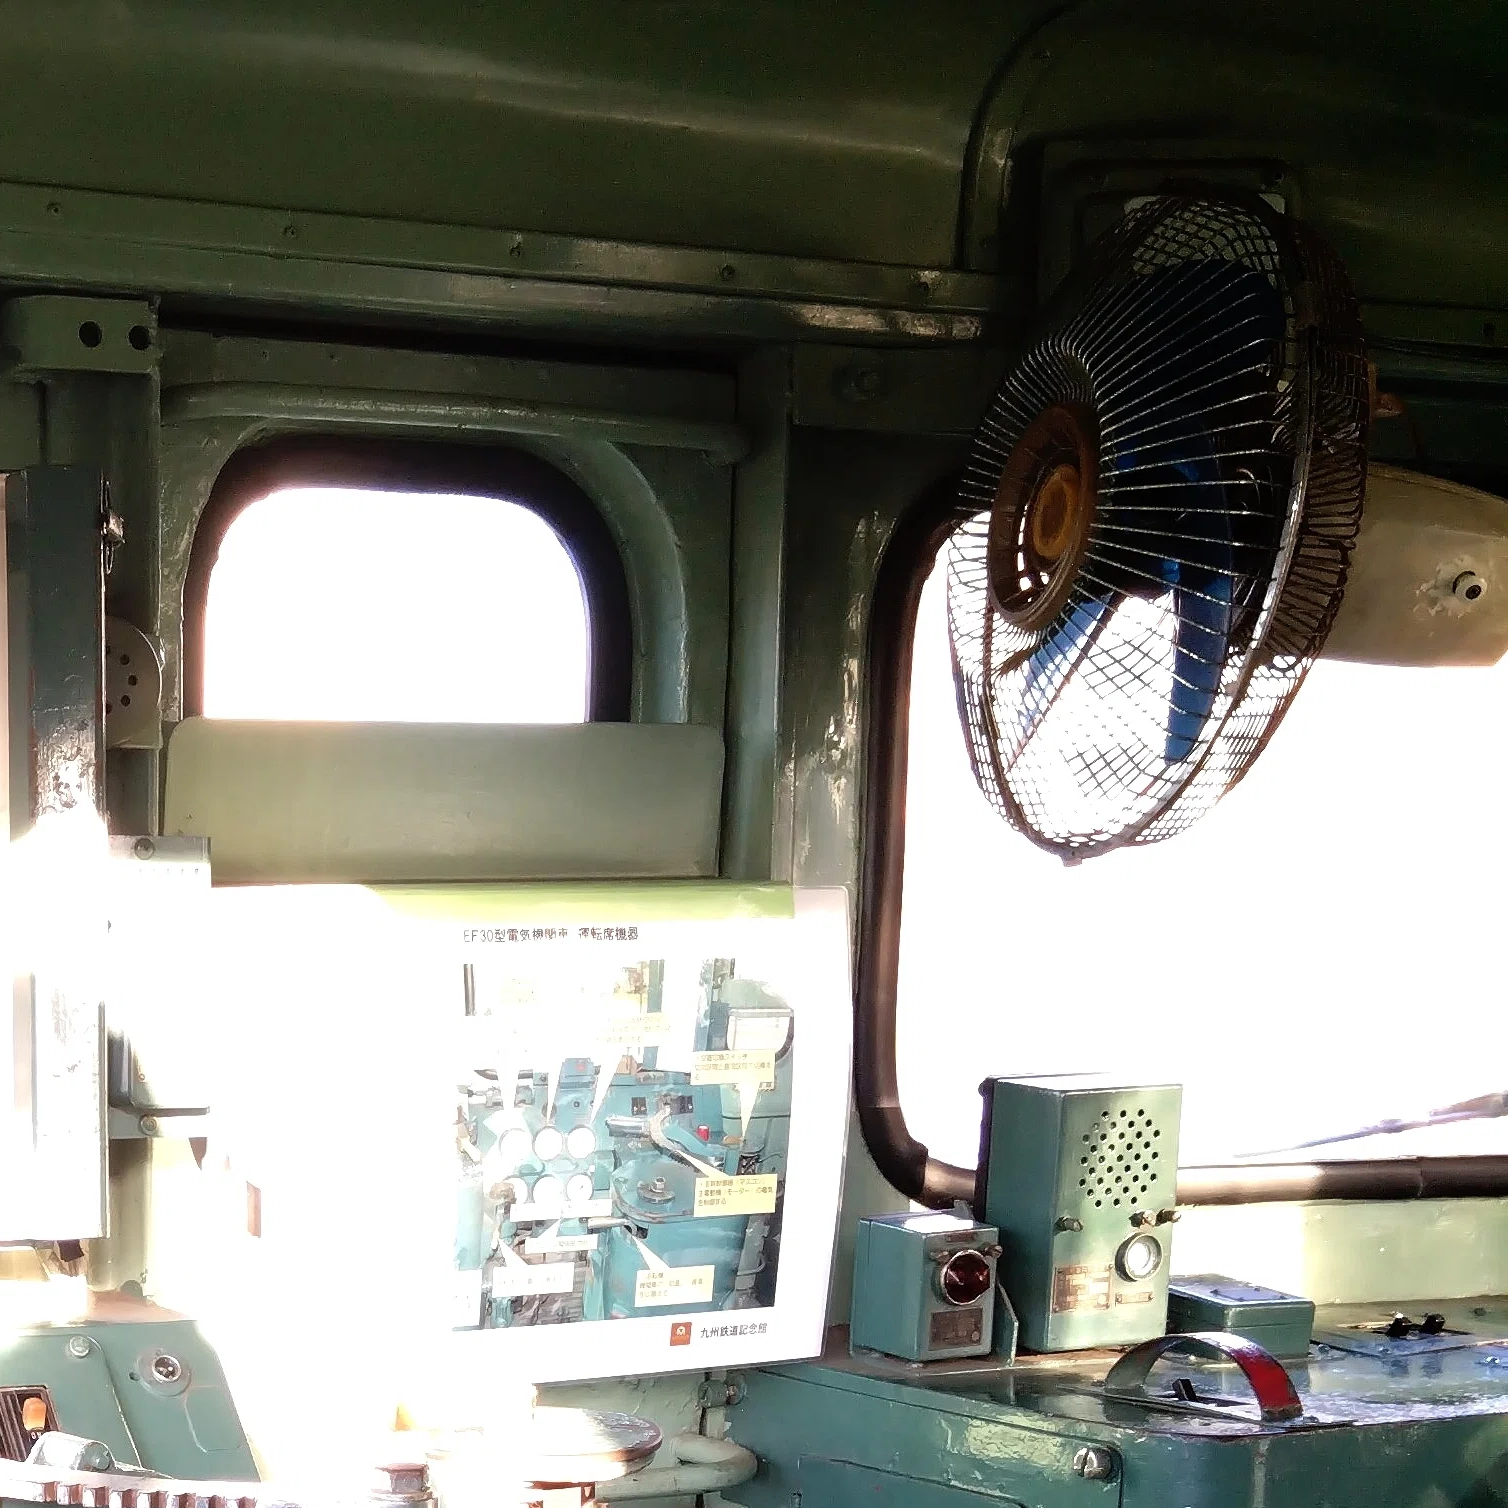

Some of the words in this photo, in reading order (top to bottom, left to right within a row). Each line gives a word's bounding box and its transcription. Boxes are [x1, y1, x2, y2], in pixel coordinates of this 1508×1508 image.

[700, 1322, 768, 1338] 九州鉄道記念館
